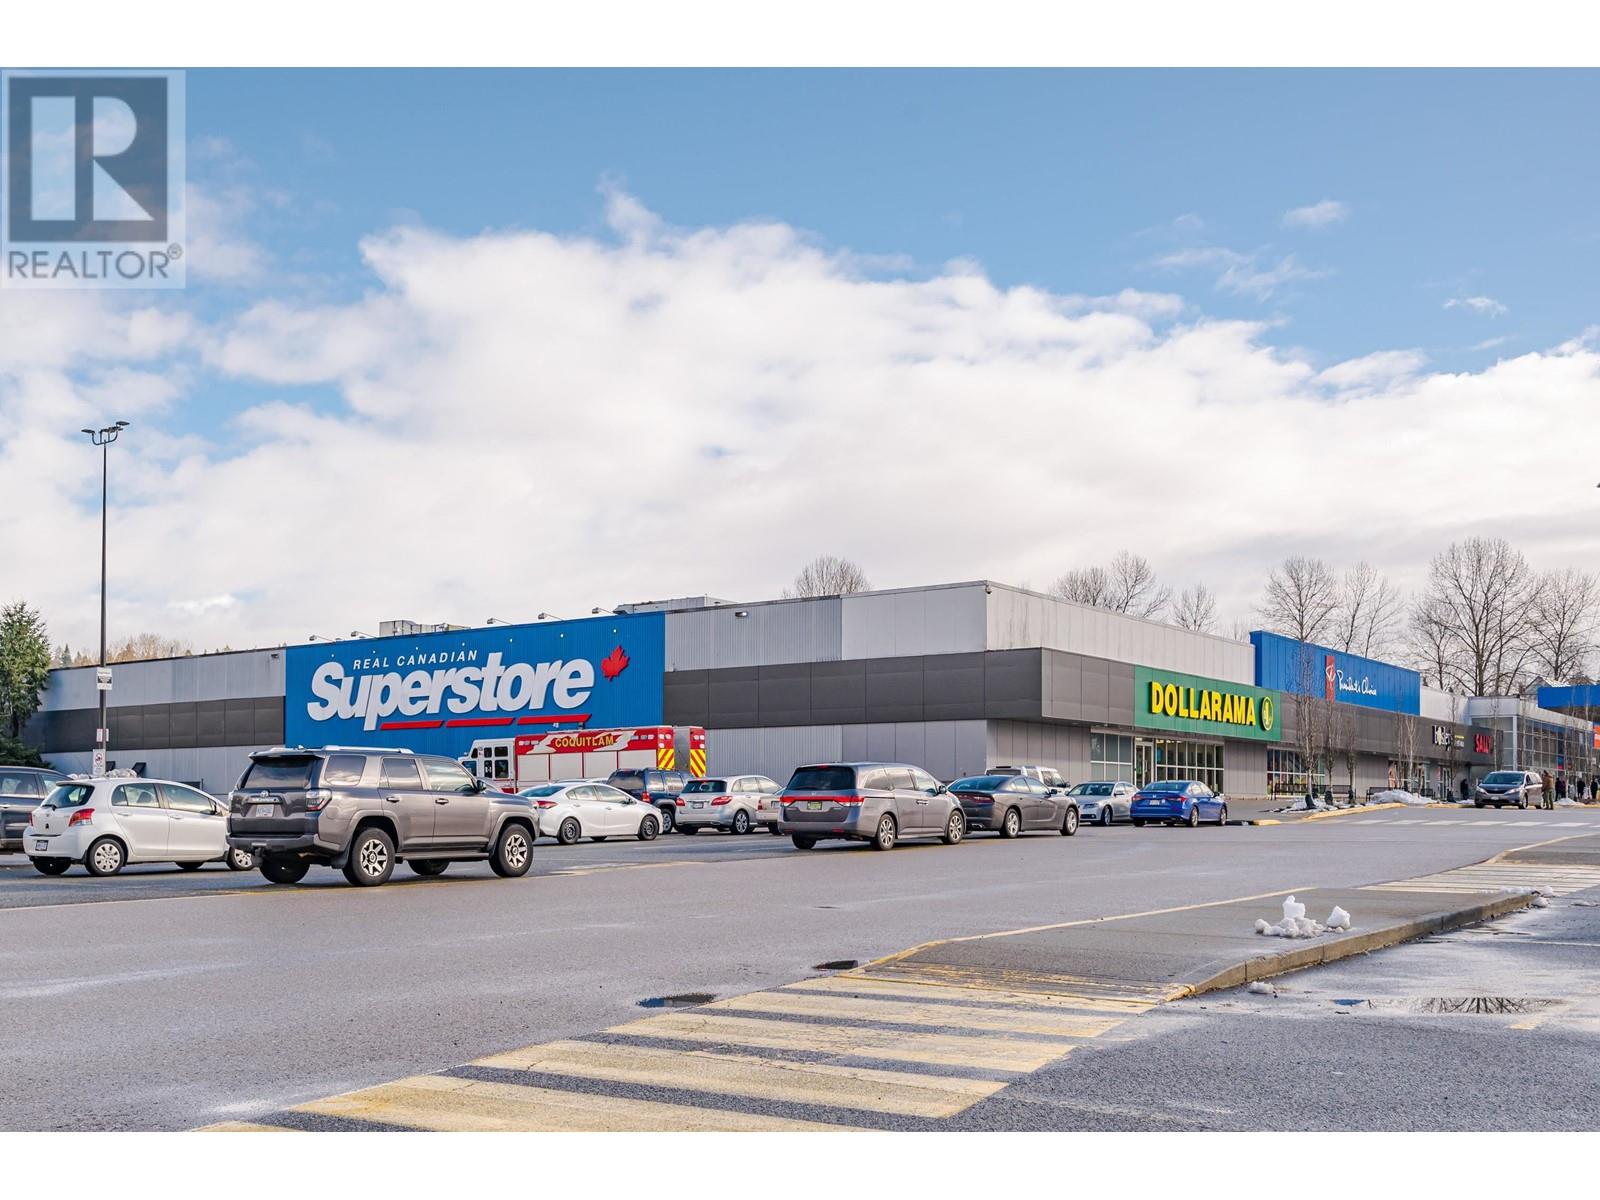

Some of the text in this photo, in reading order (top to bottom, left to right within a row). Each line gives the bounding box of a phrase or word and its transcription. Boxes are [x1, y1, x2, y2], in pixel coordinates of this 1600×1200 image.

[353, 650, 477, 670] REAL CANADIAN
[307, 652, 595, 731] Superstore
[1151, 681, 1256, 726] DOLLARAMA
[555, 735, 614, 748] COQUITLAM
